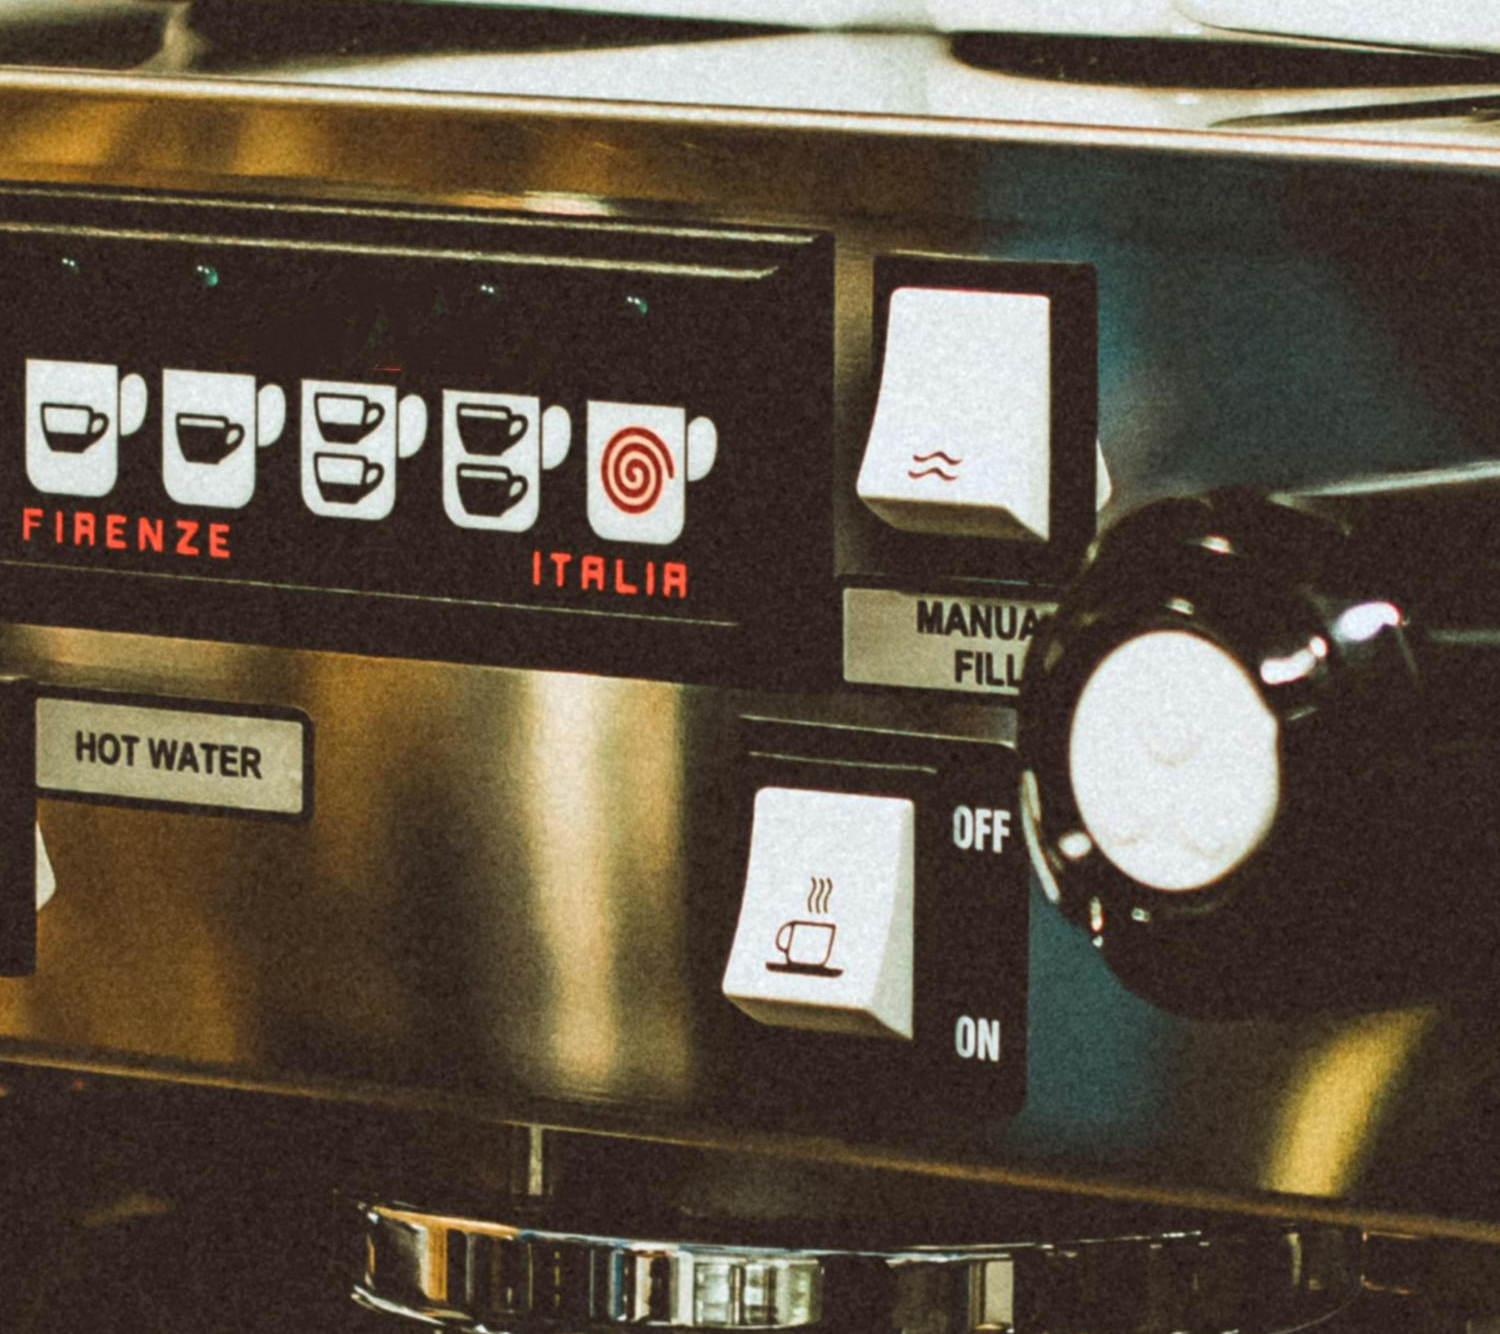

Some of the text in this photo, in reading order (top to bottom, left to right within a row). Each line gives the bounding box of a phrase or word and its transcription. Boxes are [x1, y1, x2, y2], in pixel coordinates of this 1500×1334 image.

[22, 507, 232, 560] FIRENZE
[532, 550, 689, 599] ITALIA
[916, 600, 1039, 642] MANUA
[954, 649, 1022, 687] FILL
[75, 730, 263, 780] HOT WATER
[953, 806, 1011, 853] OFF
[955, 1015, 1000, 1062] ON
